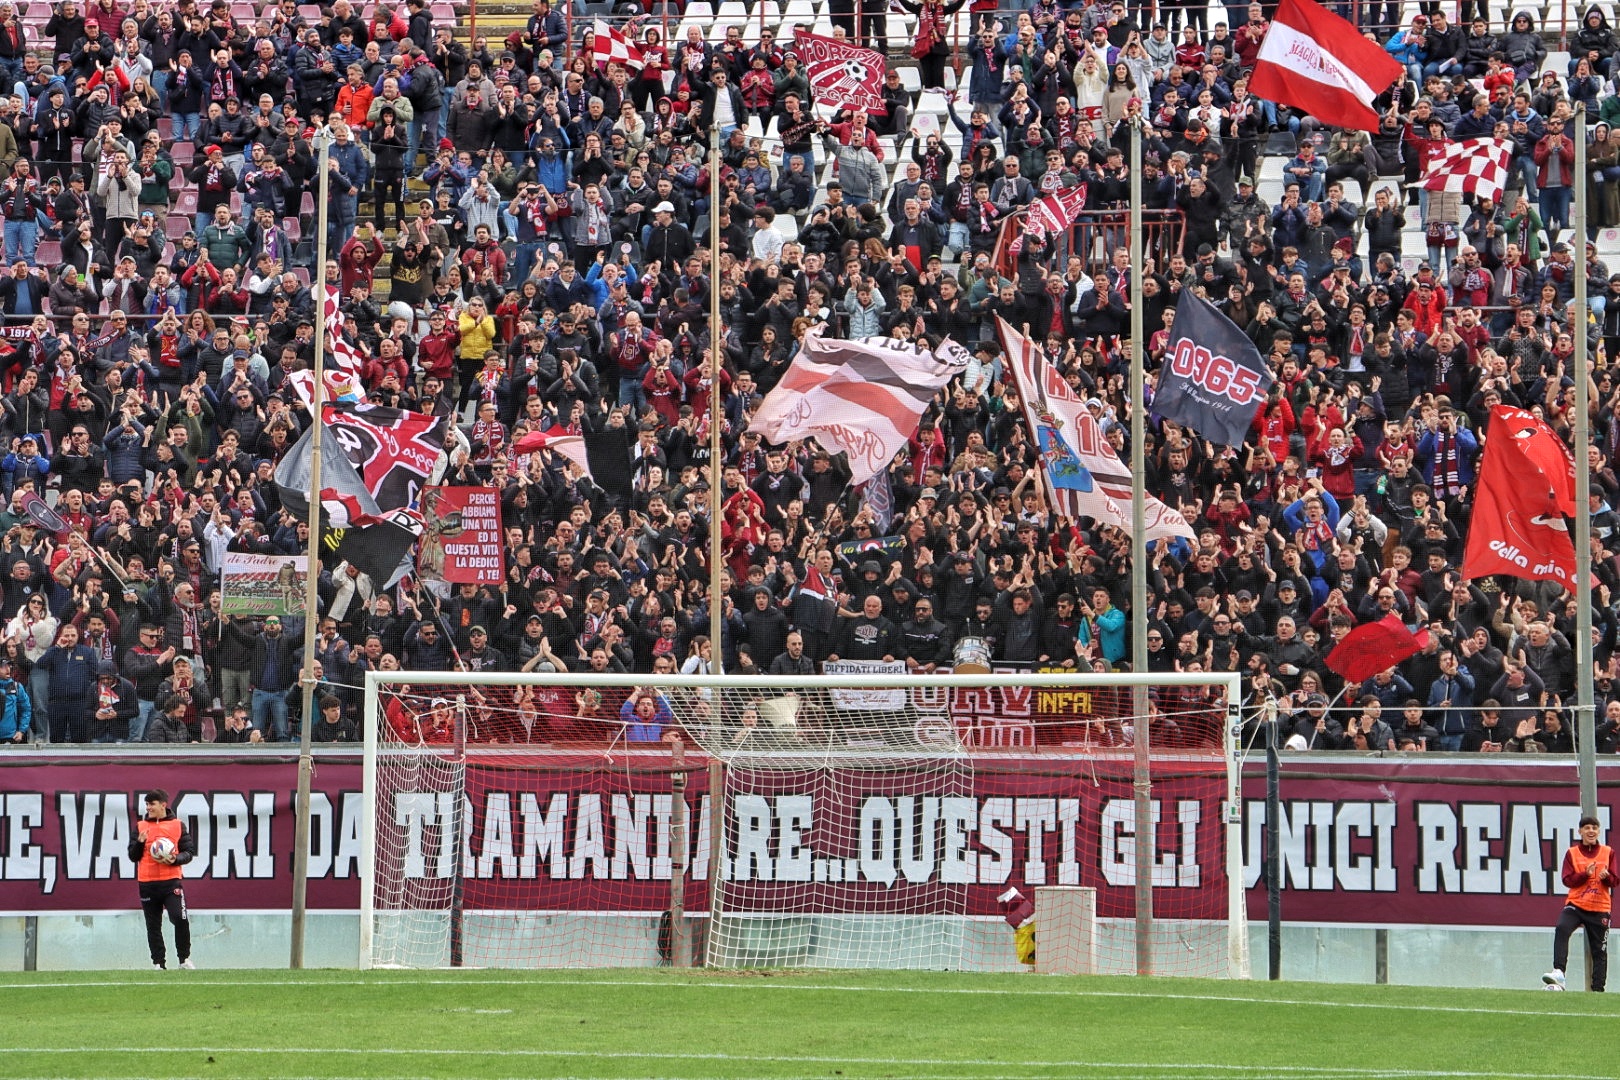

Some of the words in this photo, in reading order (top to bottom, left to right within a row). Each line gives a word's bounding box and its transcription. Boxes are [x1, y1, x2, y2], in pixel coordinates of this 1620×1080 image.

[1289, 43, 1317, 70] MAGICA
[10, 328, 31, 338] 1914
[1171, 336, 1262, 405] 0965
[462, 506, 496, 518] ABBIAMO
[461, 518, 480, 530] UNA
[482, 518, 498, 530] VITA
[478, 532, 488, 543] ED
[490, 532, 498, 543] IO
[445, 544, 480, 556] QUESTA
[482, 544, 499, 556] VITA
[456, 557, 467, 568] LA
[469, 557, 499, 568] DEDICO
[1489, 540, 1529, 569] della
[1533, 560, 1566, 580] mia
[478, 570, 485, 580] A
[486, 570, 500, 580] TE!
[825, 664, 870, 674] DIFFIDATI
[873, 665, 904, 674] LIBERI
[60, 793, 275, 879] VAORI
[1100, 799, 1200, 887] GLI
